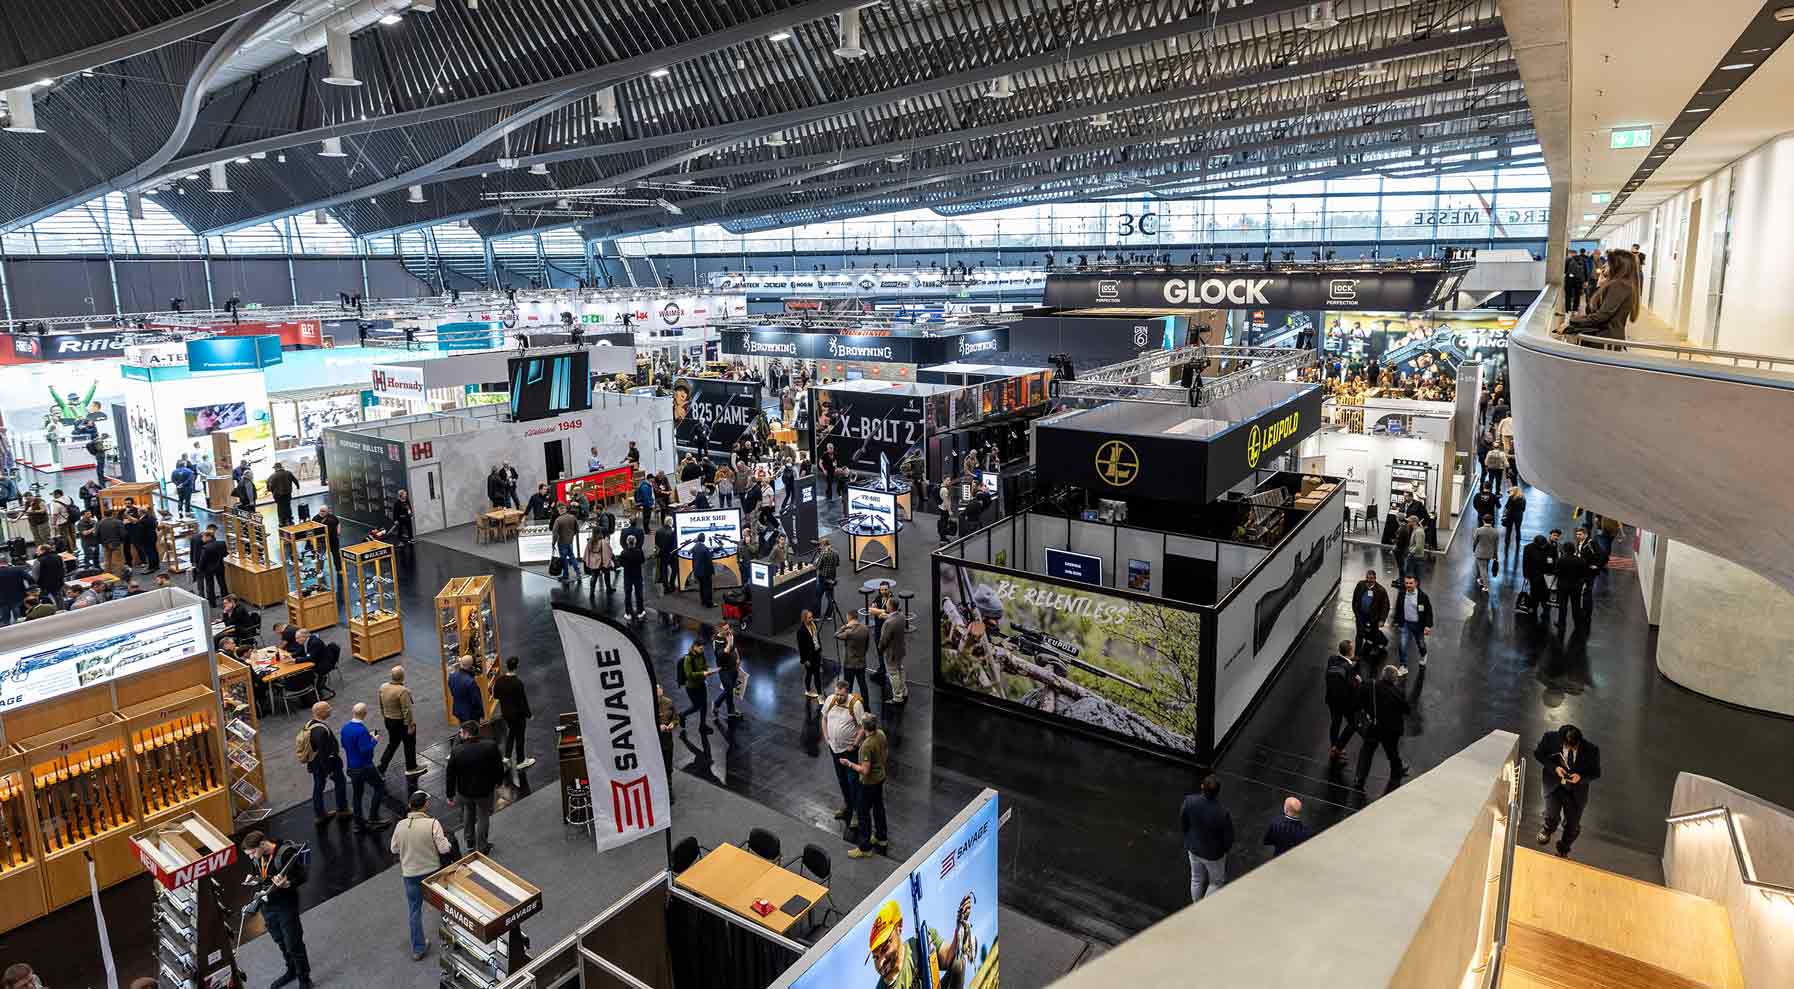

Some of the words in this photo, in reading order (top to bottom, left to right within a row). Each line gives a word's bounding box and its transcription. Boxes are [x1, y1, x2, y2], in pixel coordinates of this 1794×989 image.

[1119, 213, 1156, 236] 3C
[1164, 279, 1269, 304] GLOCK
[750, 342, 796, 354] BROWNING
[838, 346, 892, 359] BROWNING
[965, 339, 997, 355] BROWNING
[387, 377, 423, 392] Hornady
[558, 419, 583, 431] 1949
[691, 403, 713, 423] 825
[716, 404, 750, 427] GAME
[840, 414, 900, 443] X-BOLT
[904, 421, 916, 445] 2
[1262, 411, 1299, 452] LEUPOLD
[998, 580, 1019, 600] BE
[1024, 586, 1129, 624] RELENTLESS
[596, 648, 639, 771] SAVAGE
[957, 822, 989, 859] SAVAGE
[140, 850, 158, 876] NEW
[174, 848, 232, 888] NEW
[444, 903, 475, 931] SAVAGE
[505, 901, 537, 926] SAVAGE
